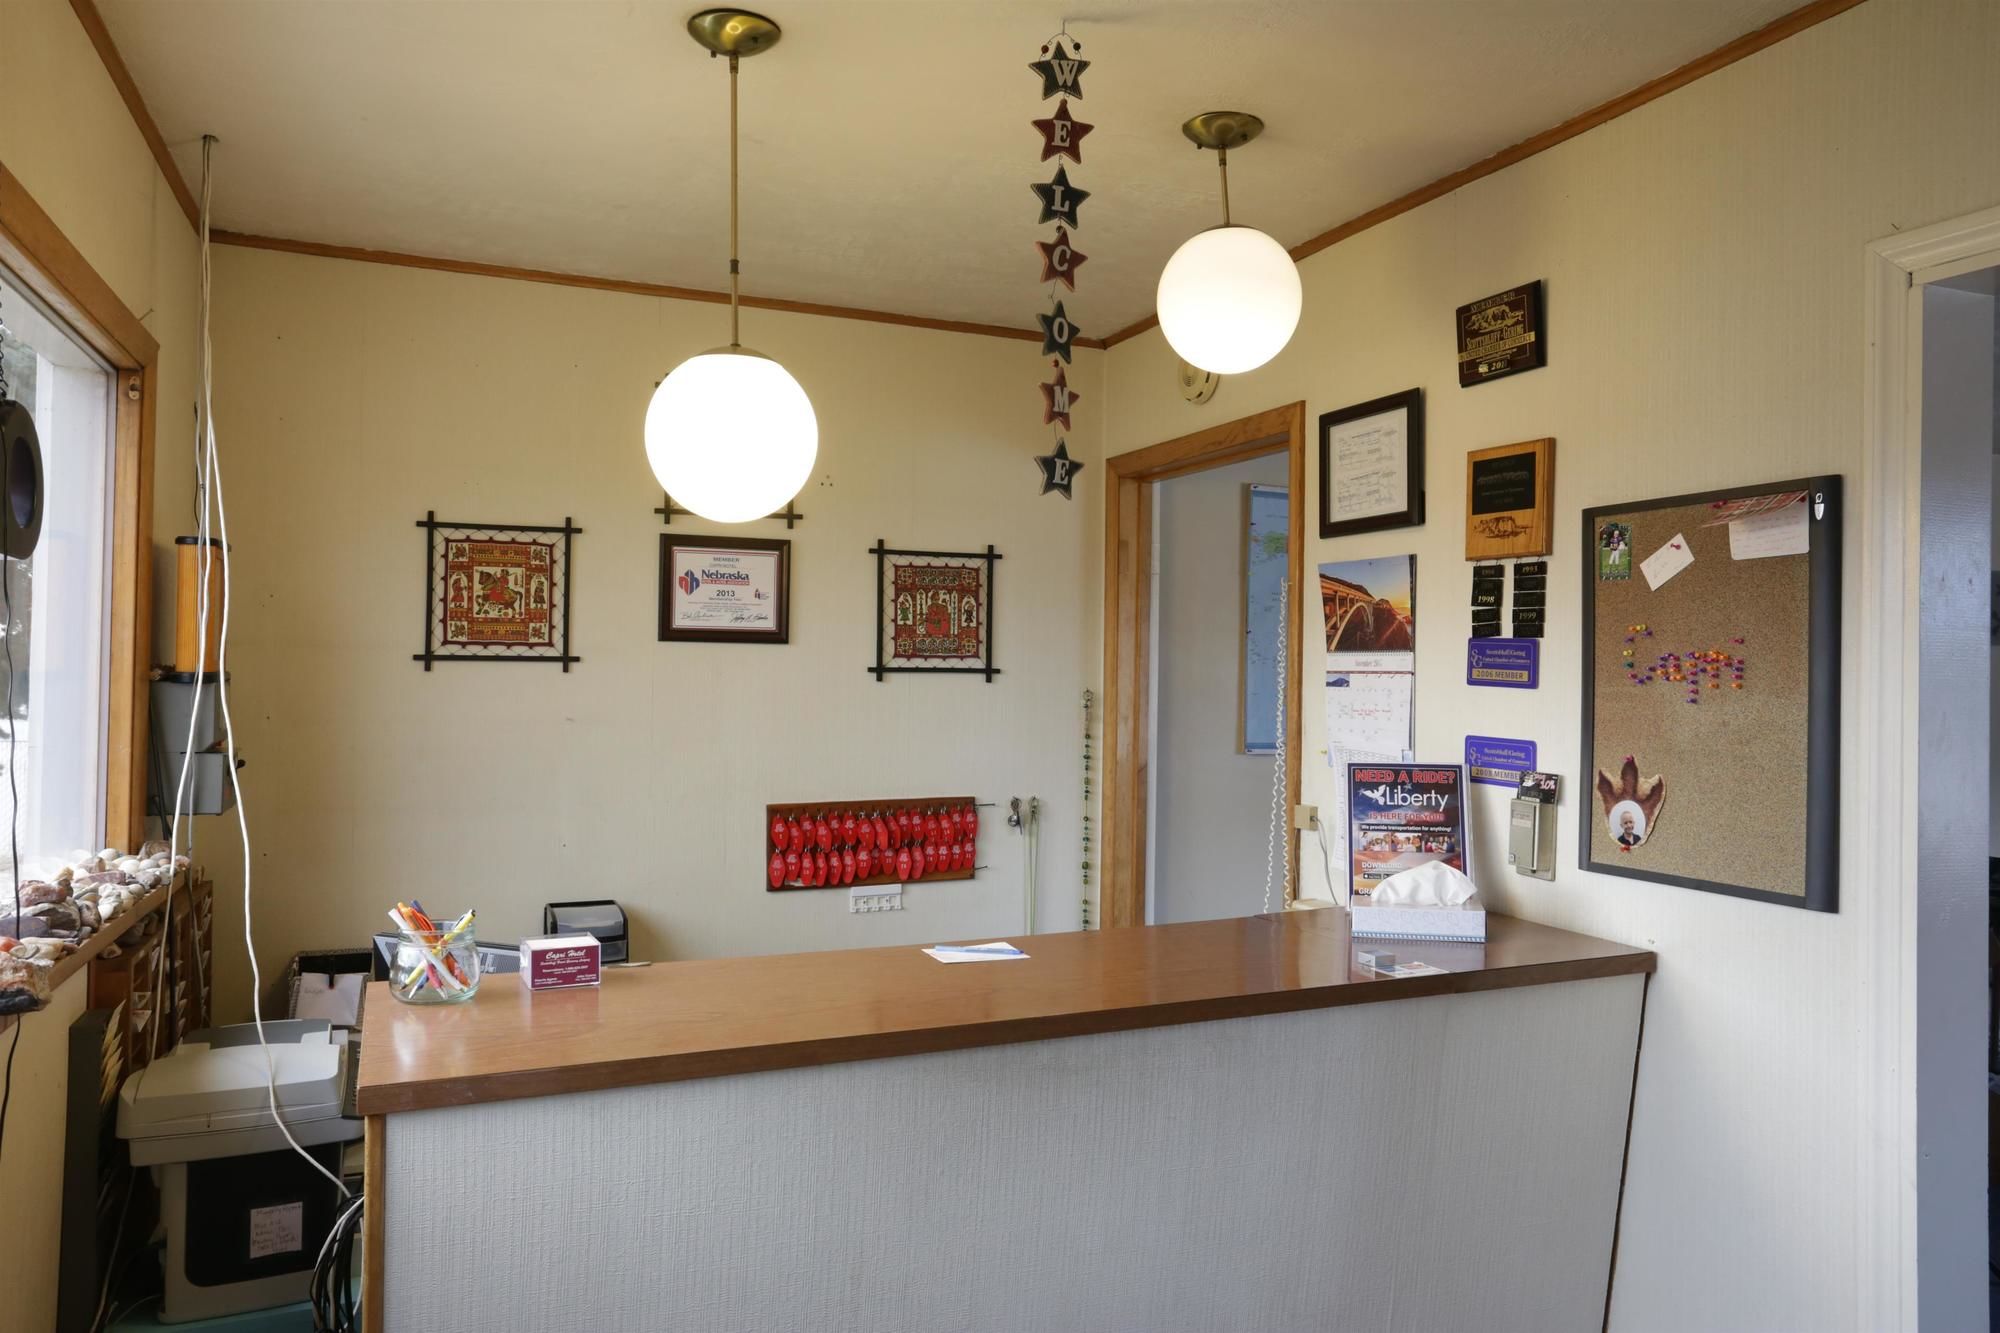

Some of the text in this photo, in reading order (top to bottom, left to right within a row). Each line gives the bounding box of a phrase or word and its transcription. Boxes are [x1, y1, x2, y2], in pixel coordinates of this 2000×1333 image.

[1050, 59, 1079, 484] WELCOME
[701, 569, 749, 580] Nebraska
[1477, 595, 1495, 603] 1998
[1519, 611, 1537, 619] 1999
[1495, 671, 1523, 679] MEMBER
[1355, 769, 1456, 784] NEED A RIDE?
[1494, 770, 1520, 779] MEMBE
[1386, 785, 1449, 812] Liberty
[1369, 812, 1378, 820] IS
[1379, 812, 1401, 820] HERE
